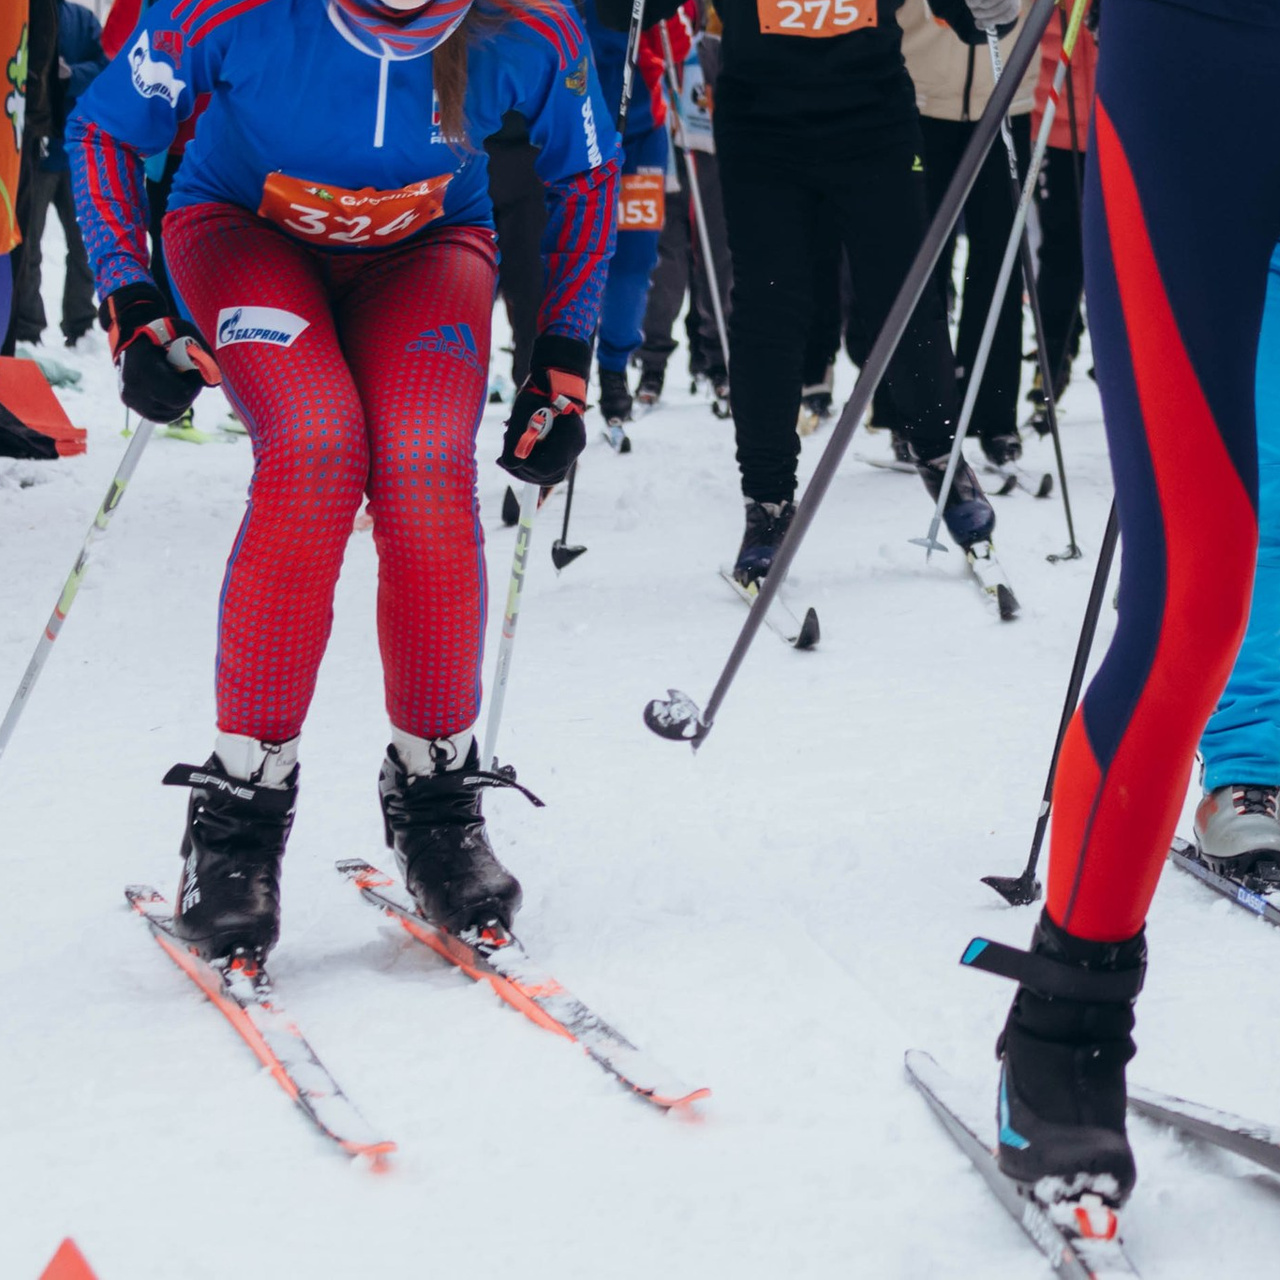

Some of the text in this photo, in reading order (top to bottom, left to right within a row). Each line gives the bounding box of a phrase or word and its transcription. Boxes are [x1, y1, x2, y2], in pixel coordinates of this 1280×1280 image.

[284, 202, 421, 243] 324
[234, 328, 292, 344] GAZPROM
[188, 772, 256, 800] SPINE
